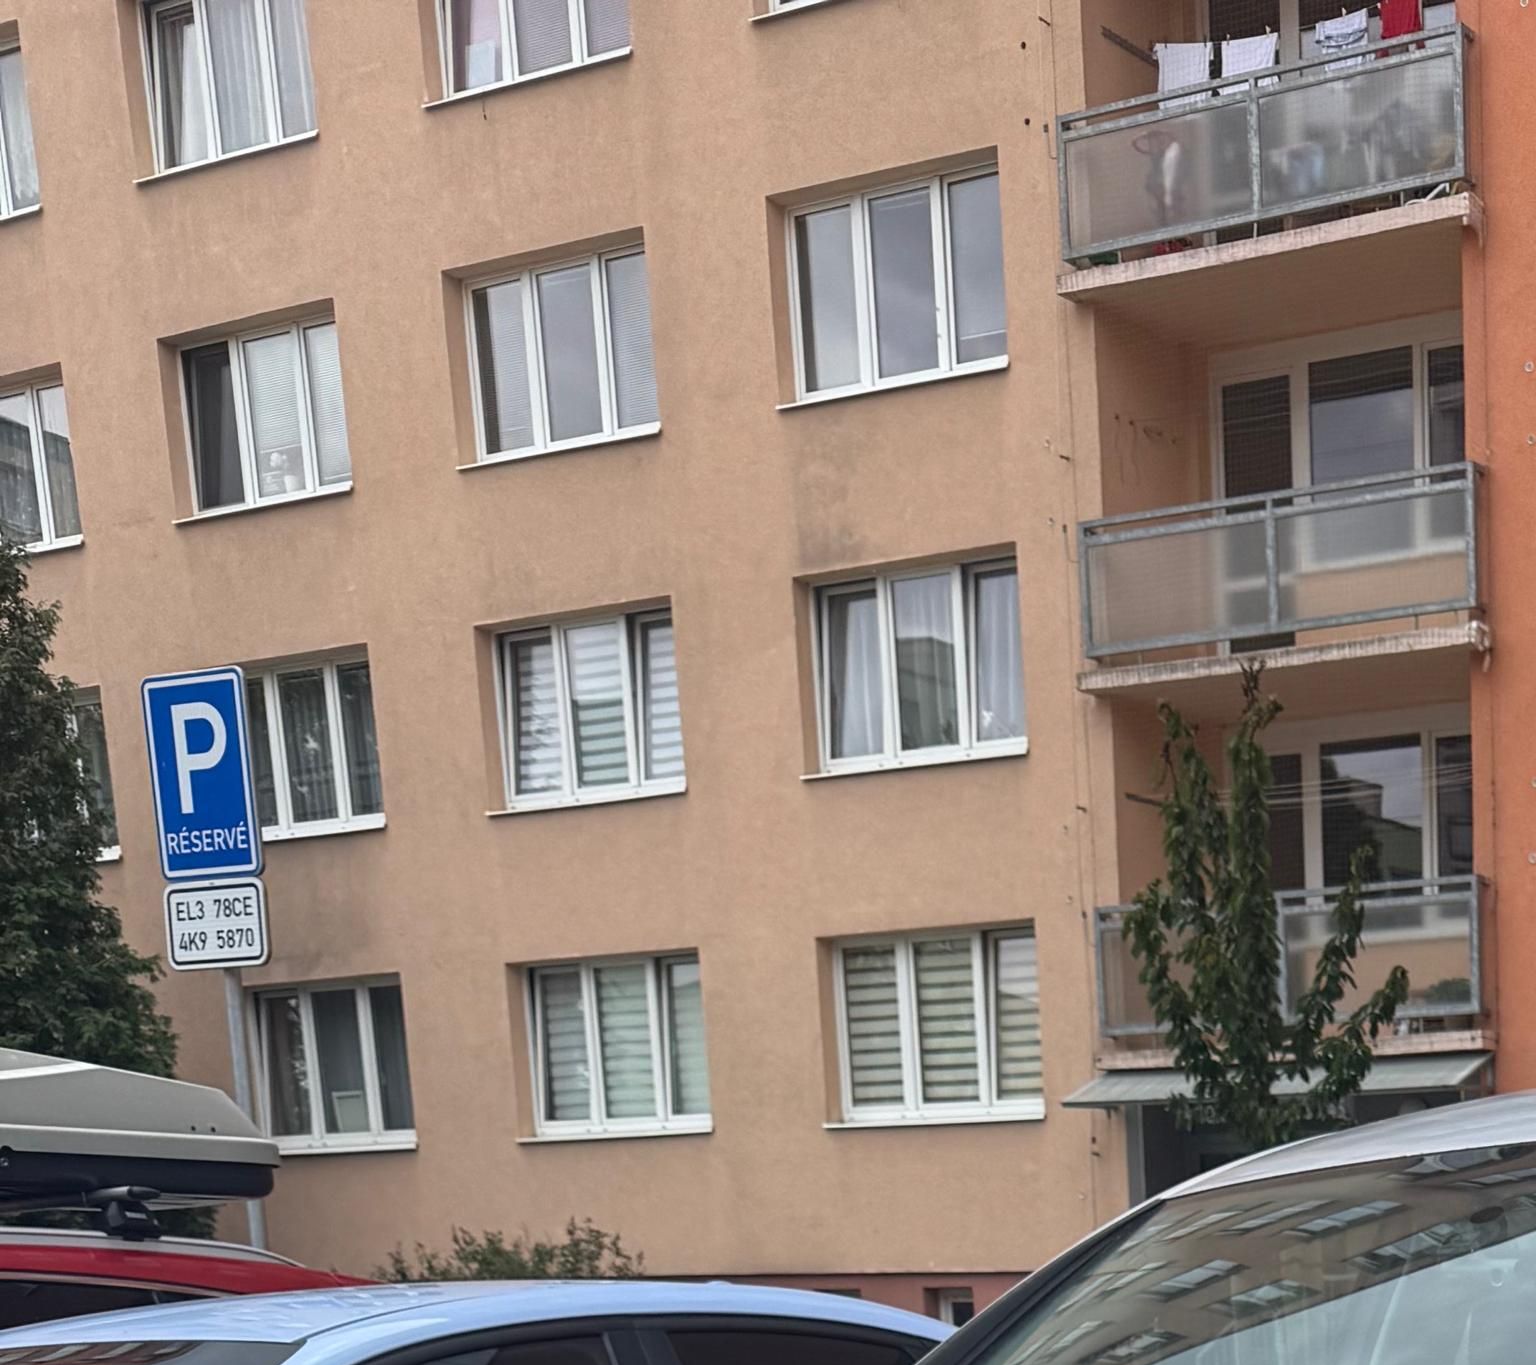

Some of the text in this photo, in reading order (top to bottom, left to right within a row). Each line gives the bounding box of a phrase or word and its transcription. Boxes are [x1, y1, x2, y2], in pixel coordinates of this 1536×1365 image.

[170, 701, 227, 814] P
[166, 821, 248, 855] RÉSERVÉ
[175, 896, 254, 921] EL3 78CE
[179, 927, 255, 952] 4K9 5870
